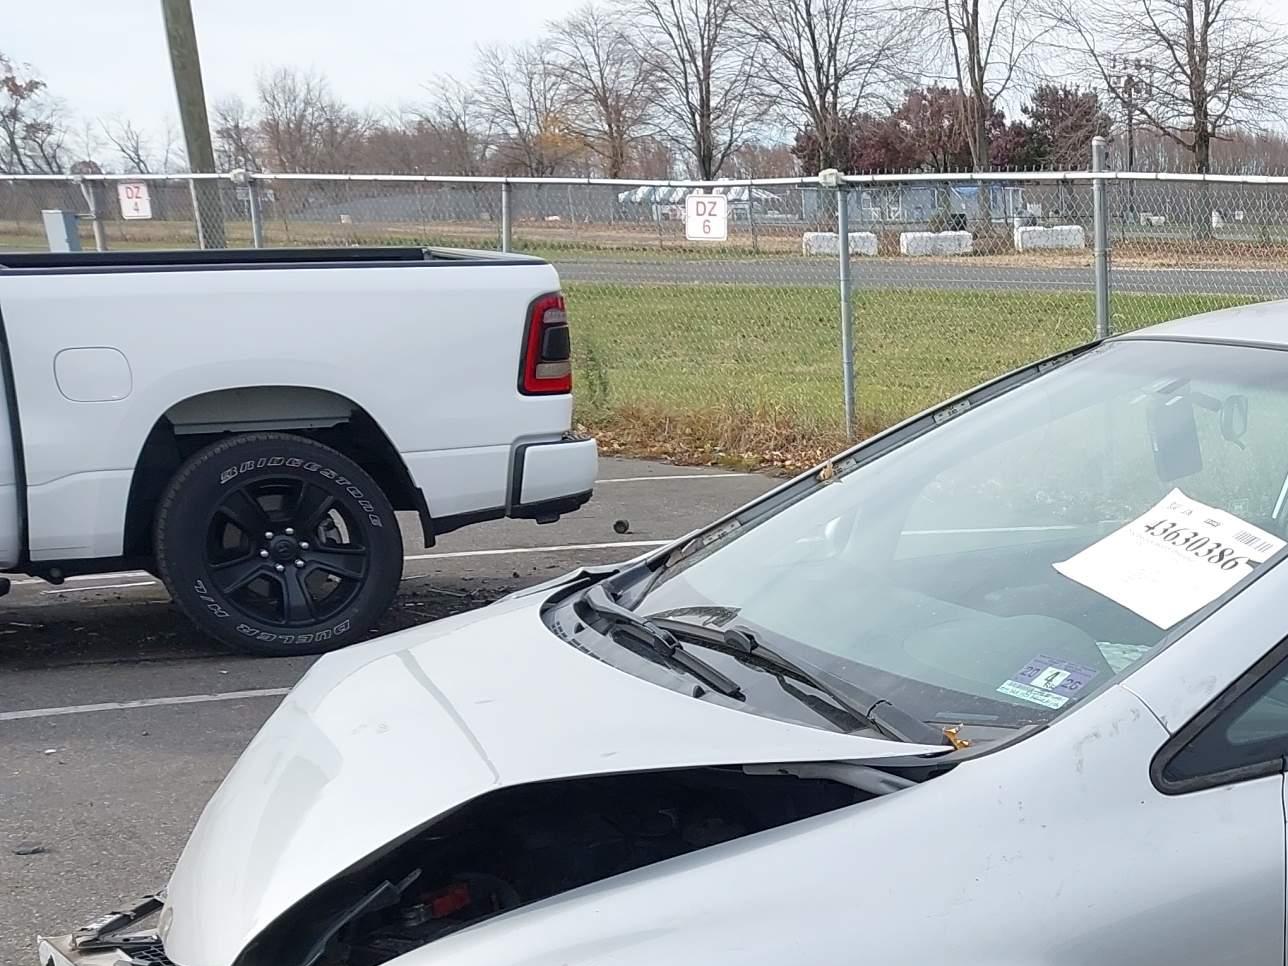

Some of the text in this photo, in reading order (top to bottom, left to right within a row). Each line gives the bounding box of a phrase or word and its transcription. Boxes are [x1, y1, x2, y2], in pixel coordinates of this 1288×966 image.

[125, 185, 142, 200] DZ
[695, 200, 718, 217] DZ
[702, 219, 712, 235] 6
[219, 456, 384, 528] BRIDGESTONE
[1143, 518, 1249, 572] 43630386
[235, 618, 351, 645] DUELER
[1020, 665, 1041, 678] 20
[1043, 671, 1061, 683] 4
[1060, 678, 1082, 690] 26
